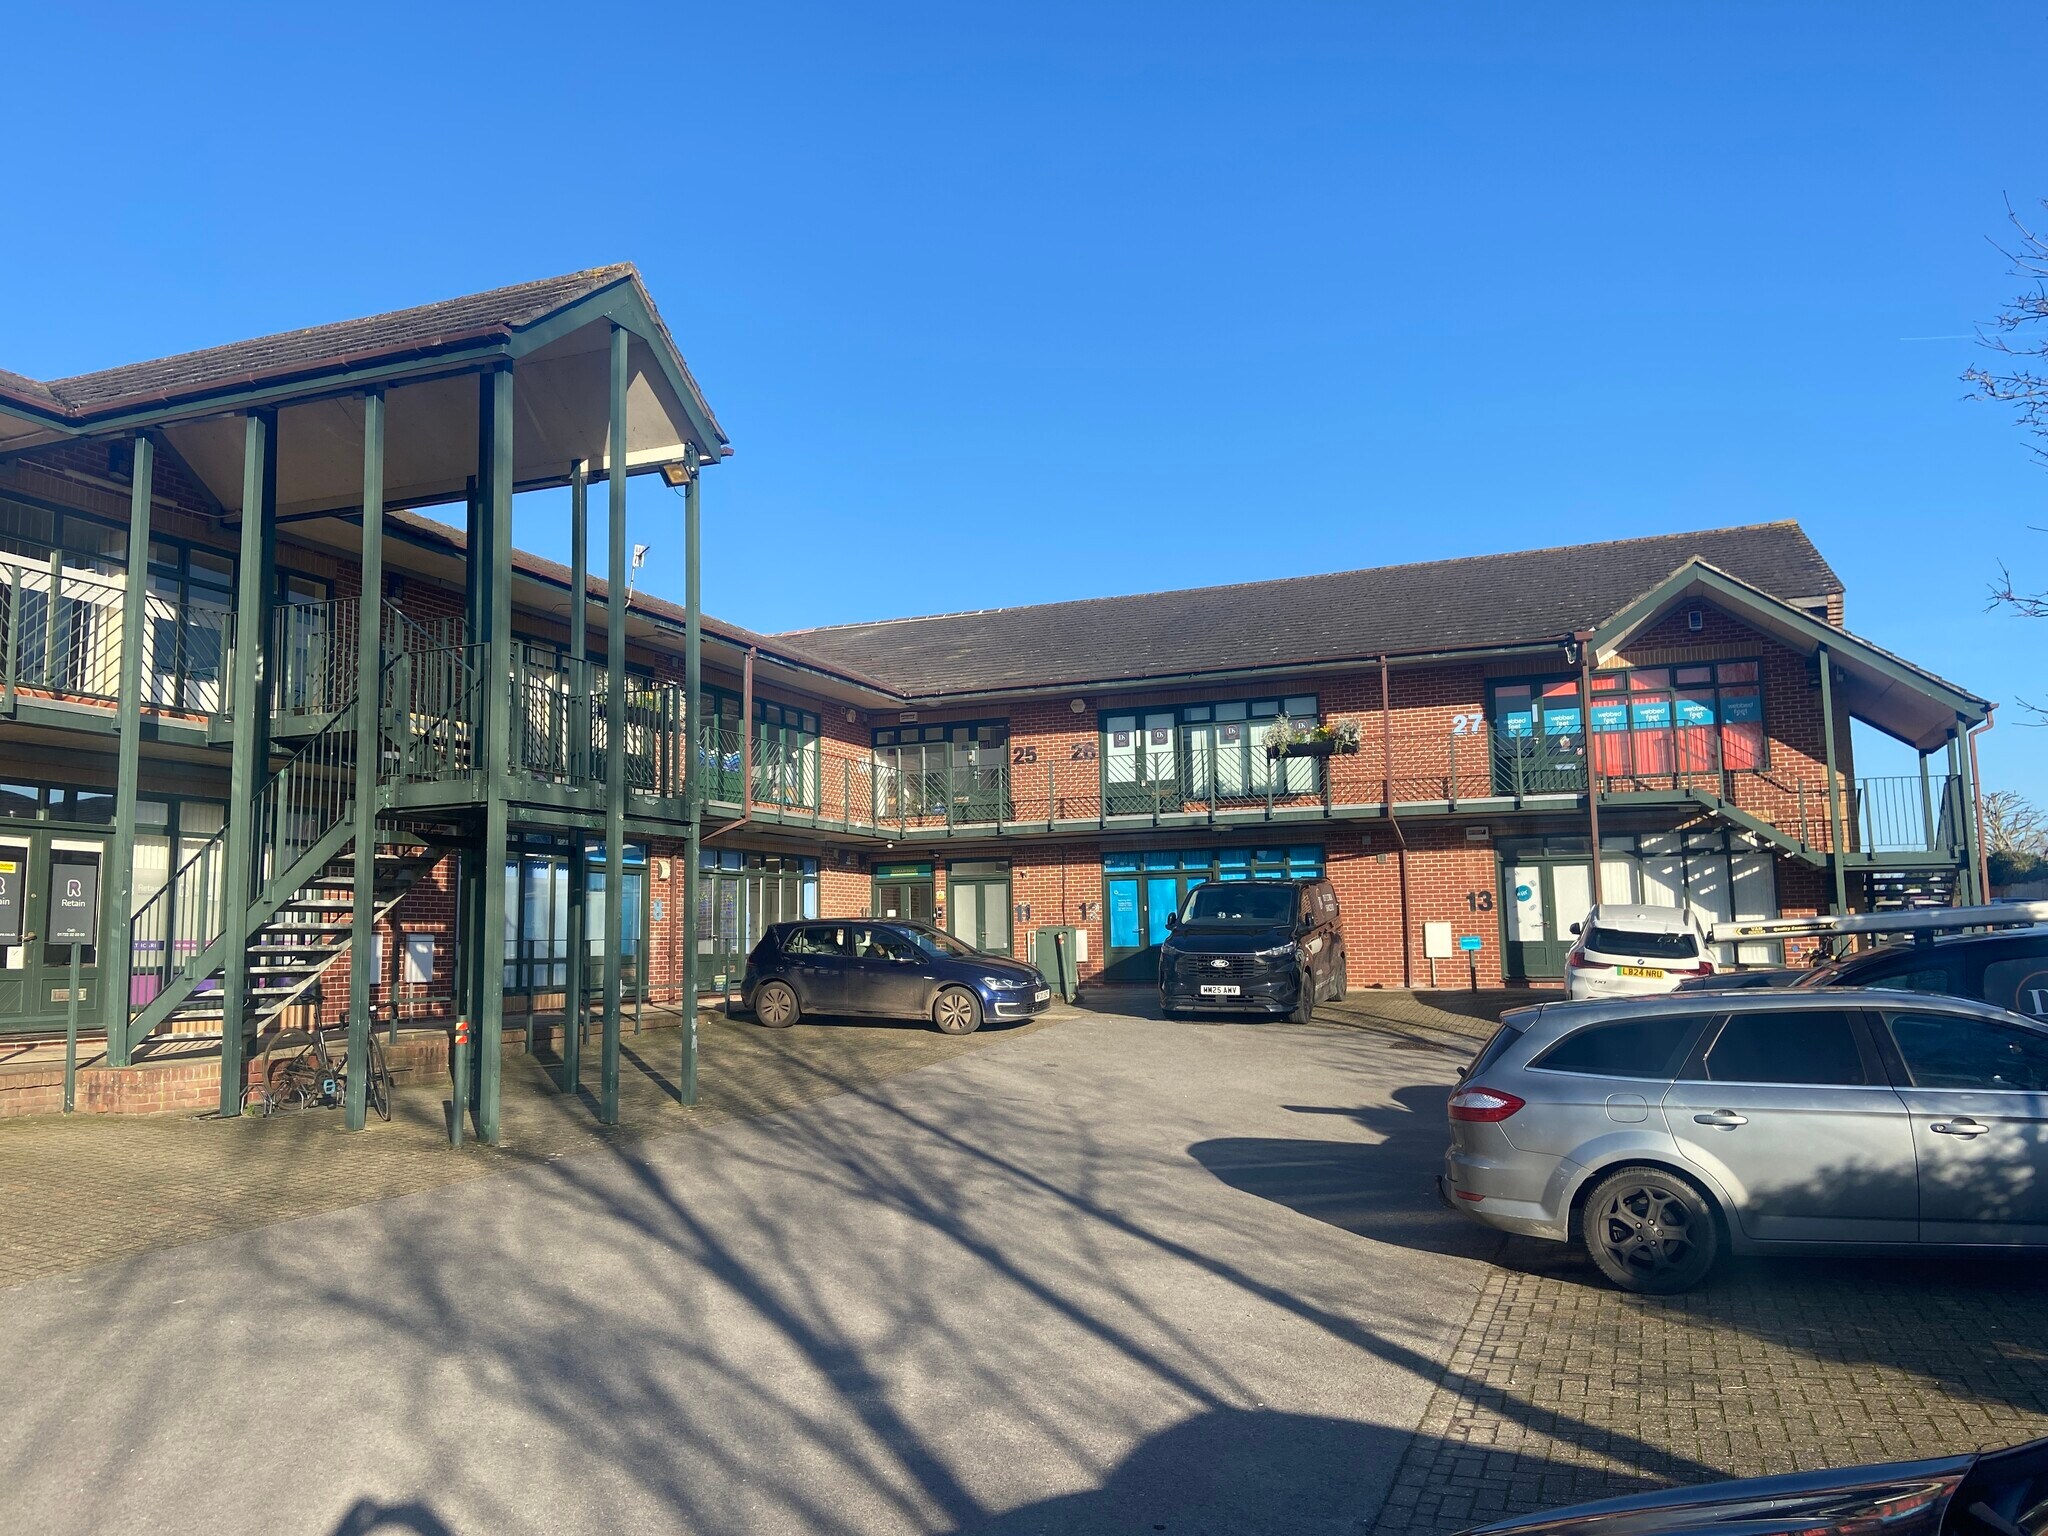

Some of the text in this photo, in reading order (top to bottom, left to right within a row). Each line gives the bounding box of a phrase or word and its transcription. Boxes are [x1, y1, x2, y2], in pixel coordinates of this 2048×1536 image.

[1689, 712, 1704, 720] feet
[1734, 708, 1748, 716] feet
[1503, 717, 1526, 725] webbed
[1551, 714, 1575, 722] webbed
[1604, 717, 1617, 725] feet
[1452, 713, 1483, 735] 27
[1508, 724, 1521, 732] feet
[1013, 746, 1038, 764] 25
[62, 898, 86, 907] Retain
[1466, 890, 1493, 912] 13
[653, 898, 663, 921] 8
[1015, 904, 1030, 922] 11
[1622, 968, 1662, 978] LB24 NRU
